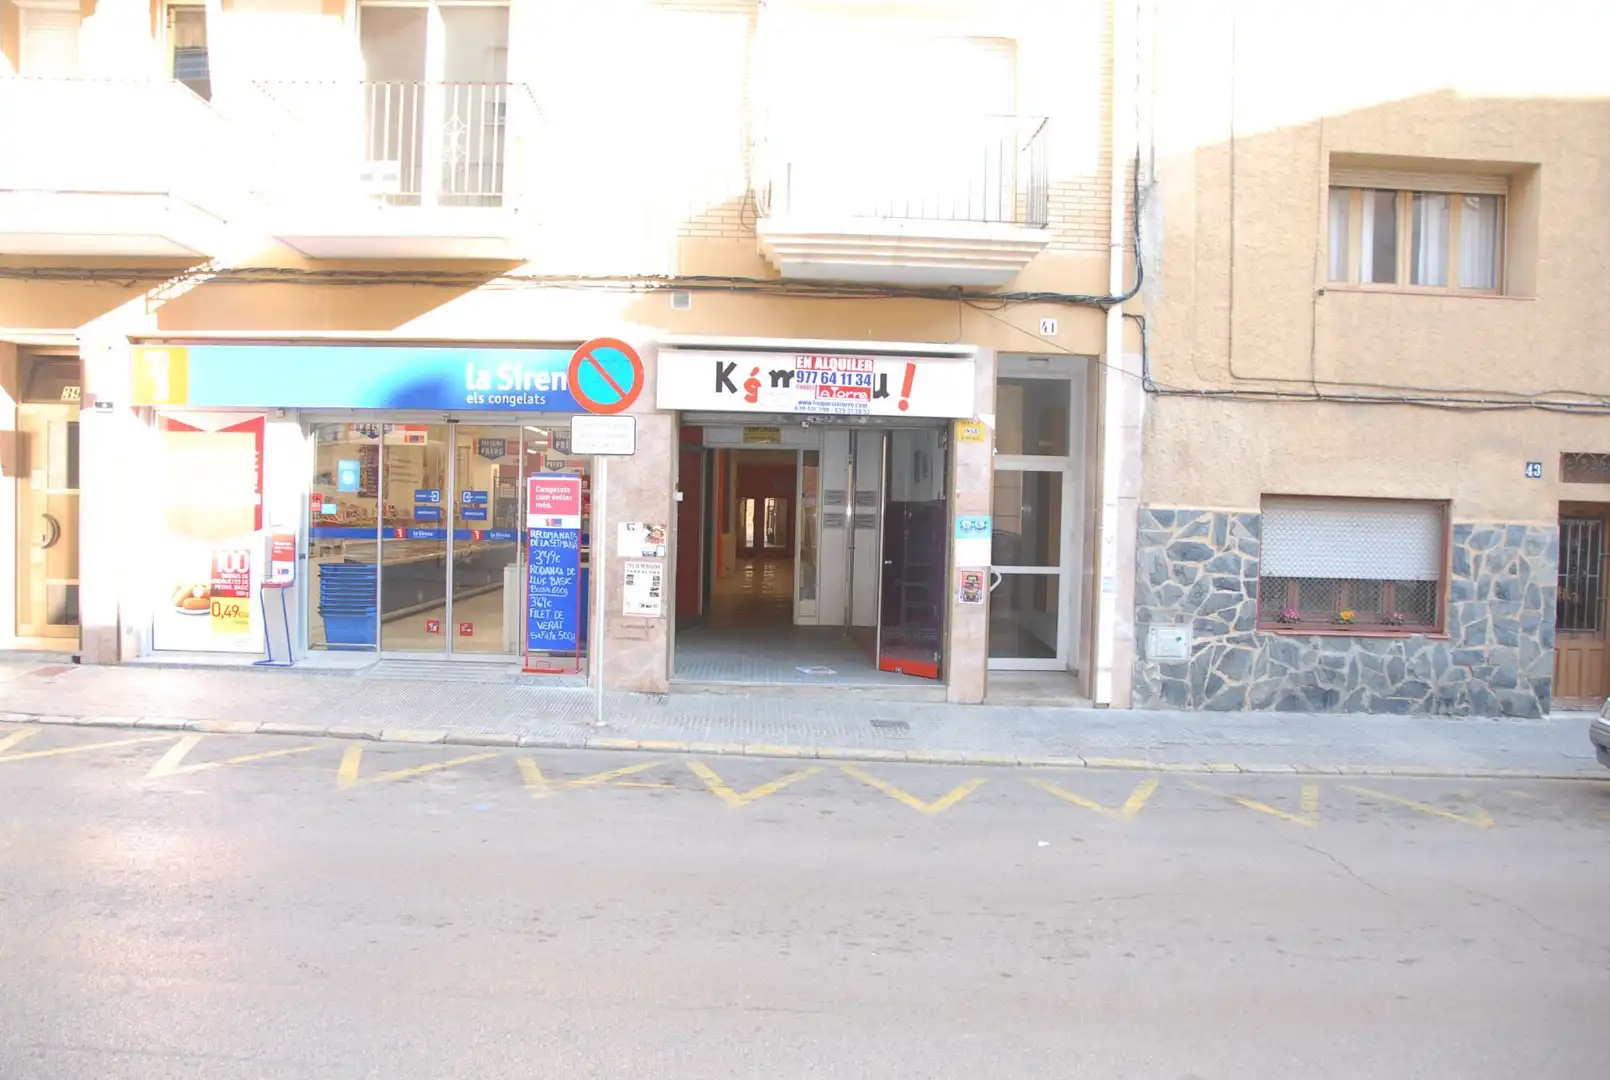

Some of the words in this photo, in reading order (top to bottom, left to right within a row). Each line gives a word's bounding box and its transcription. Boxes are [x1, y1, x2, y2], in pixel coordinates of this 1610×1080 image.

[796, 356, 812, 369] EN
[814, 356, 873, 372] ALQUILER
[496, 363, 567, 392] Siren
[796, 370, 818, 384] 977
[821, 371, 837, 385] 64
[841, 373, 852, 386] 11
[855, 373, 871, 387] 34
[466, 393, 484, 404] els
[488, 393, 546, 407] congelats
[1526, 463, 1541, 477] 43
[535, 486, 571, 494] Congelats
[216, 550, 249, 574] 100
